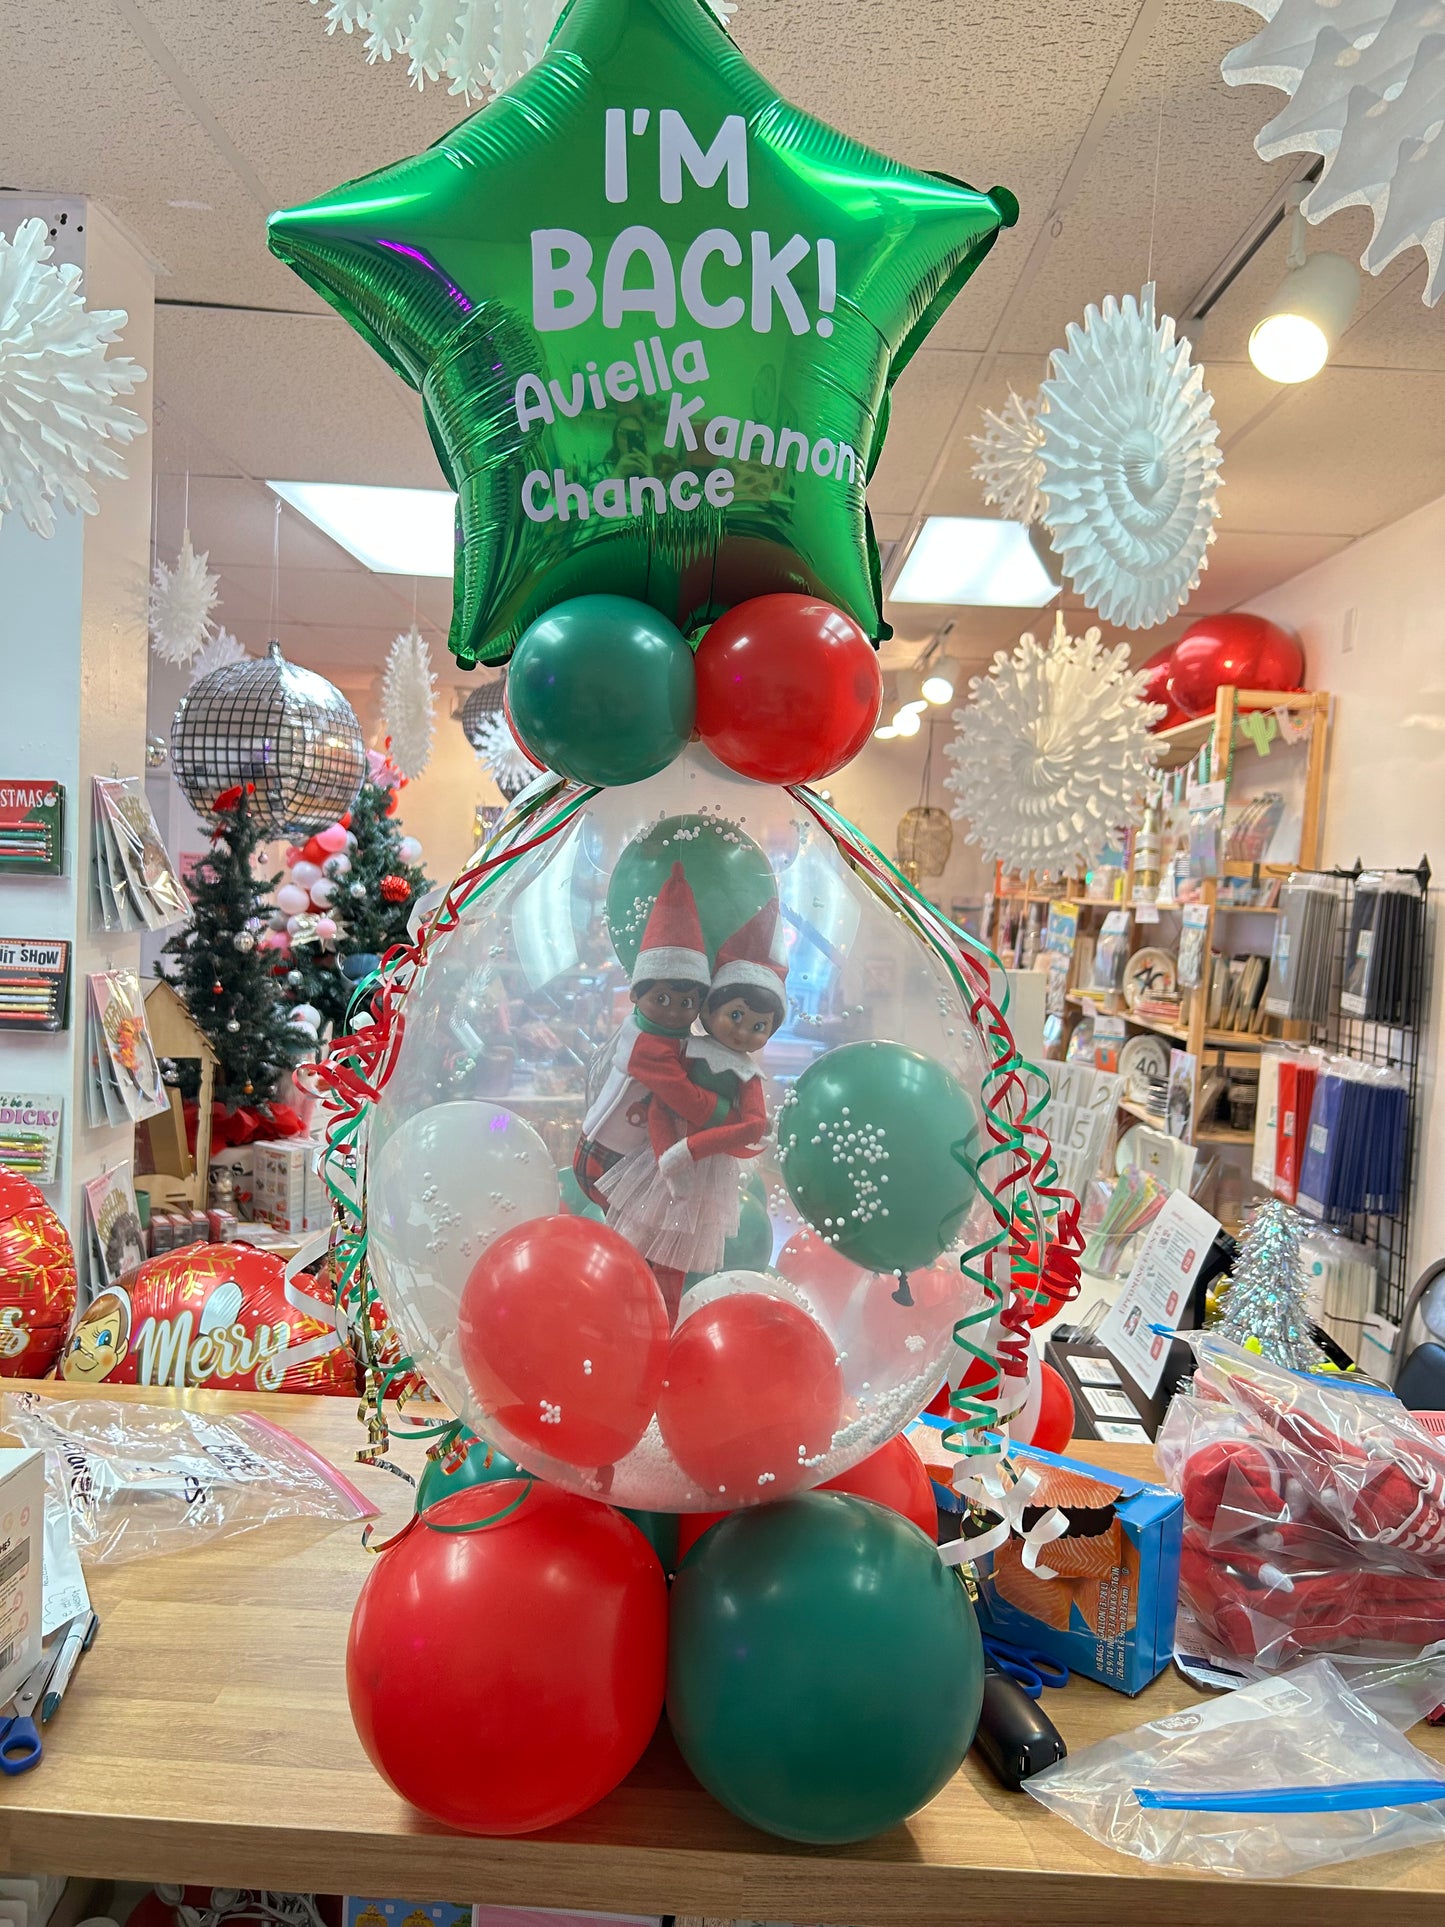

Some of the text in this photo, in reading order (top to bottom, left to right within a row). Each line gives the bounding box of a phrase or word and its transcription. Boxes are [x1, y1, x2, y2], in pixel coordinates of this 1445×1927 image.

[605, 108, 749, 209] I'M
[530, 225, 837, 338] BACK!
[514, 336, 709, 432] Aviella
[664, 393, 856, 484] Kannon
[521, 468, 735, 522] Chance
[0, 1108, 59, 1127] DICK!
[134, 1309, 290, 1392] Merry
[1096, 1643, 1105, 1663] BAGS
[1098, 1610, 1106, 1638] GALLON
